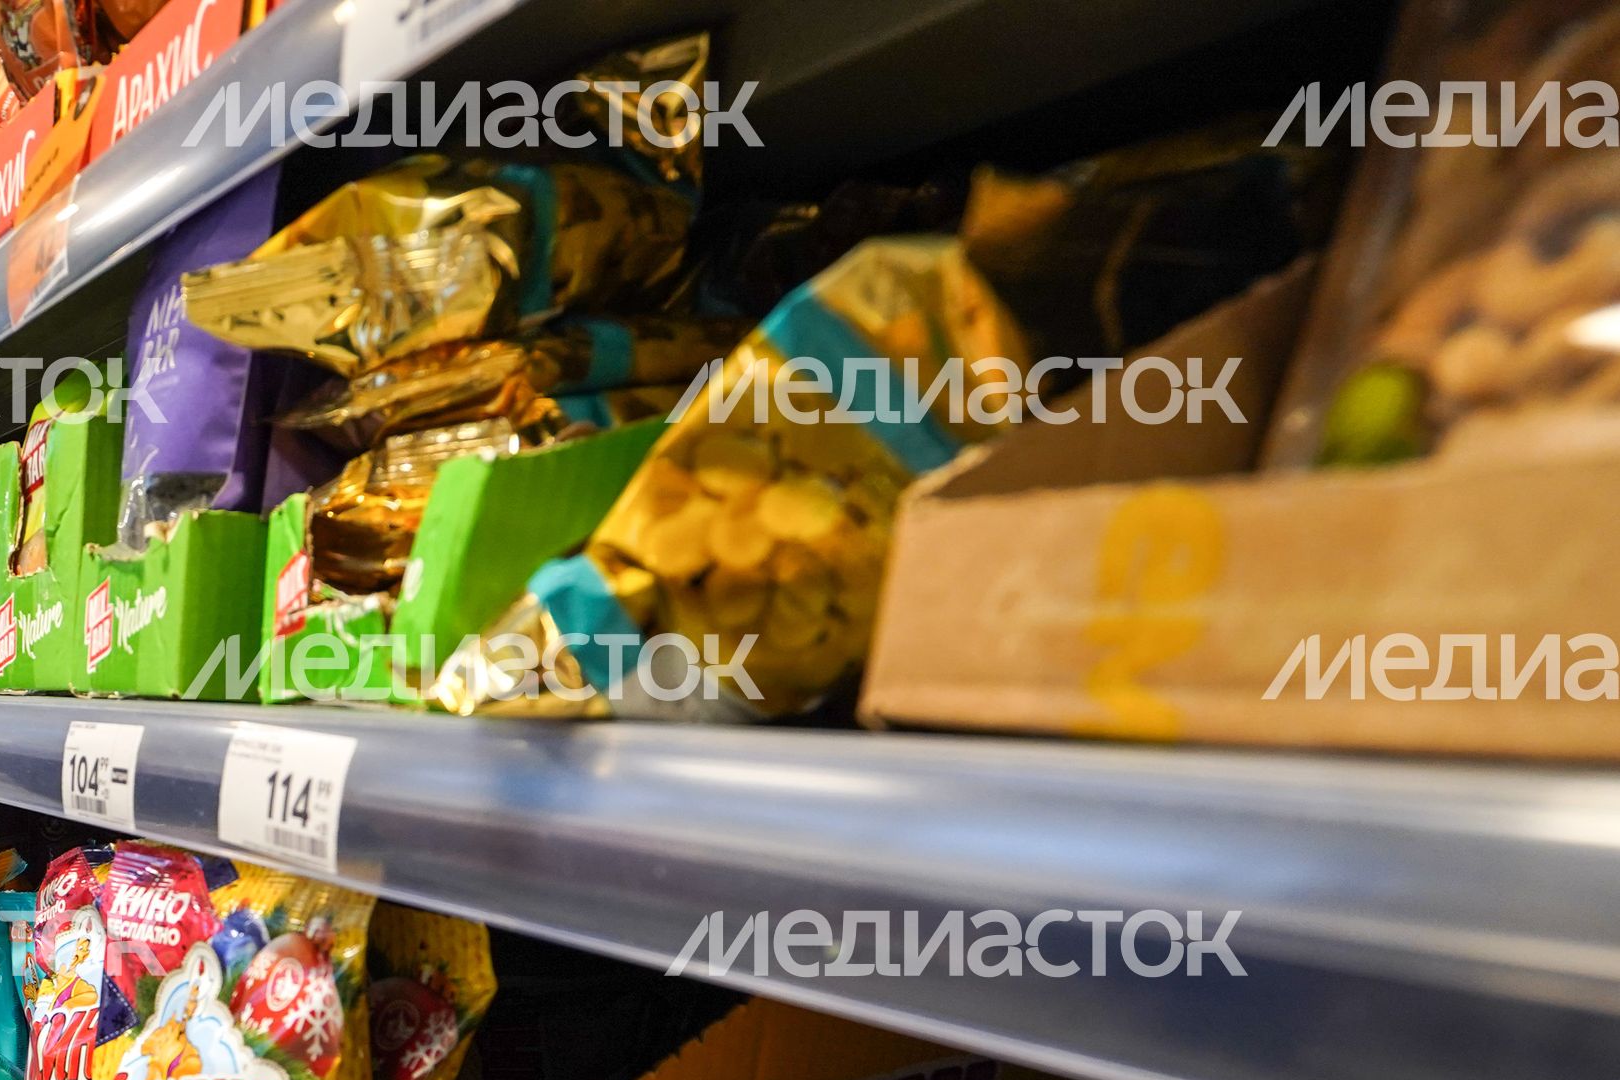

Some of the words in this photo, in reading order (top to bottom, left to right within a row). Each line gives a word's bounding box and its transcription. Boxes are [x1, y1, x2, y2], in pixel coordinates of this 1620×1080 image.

[111, 0, 217, 146] АРАХИС
[18, 600, 63, 660] Nature
[115, 585, 167, 655] Nature
[69, 753, 99, 797] 104
[267, 769, 314, 828] 114
[110, 882, 191, 925] КИНО
